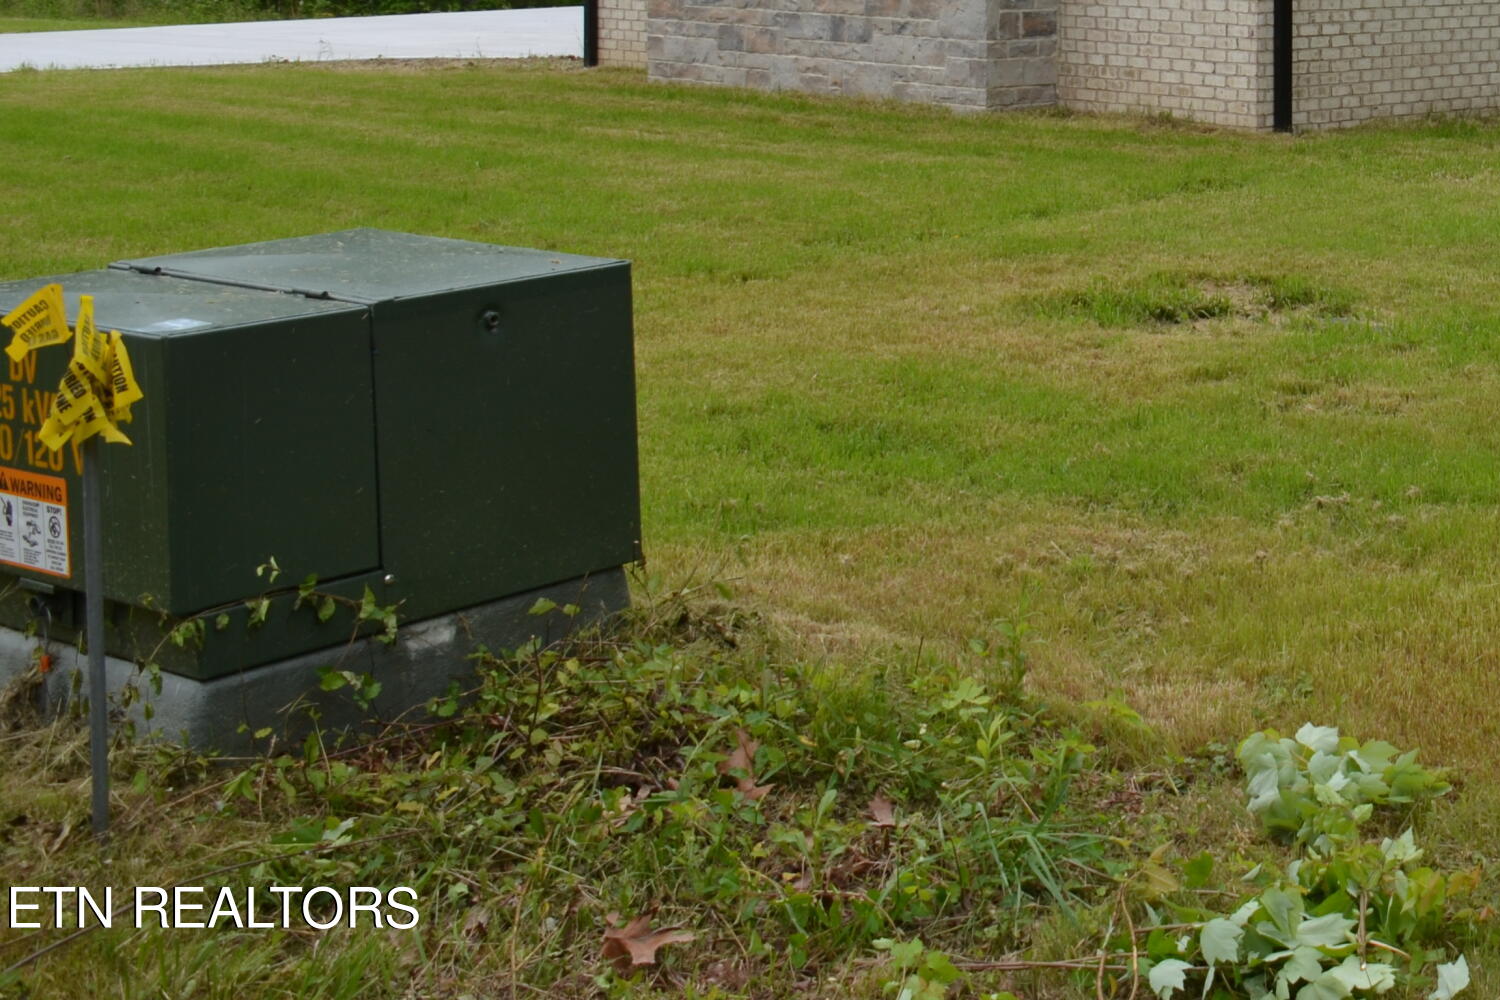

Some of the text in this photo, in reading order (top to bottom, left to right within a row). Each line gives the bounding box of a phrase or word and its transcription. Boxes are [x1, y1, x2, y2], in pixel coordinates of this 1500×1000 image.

[0, 384, 57, 425] 5 kV
[11, 477, 63, 503] WARNING
